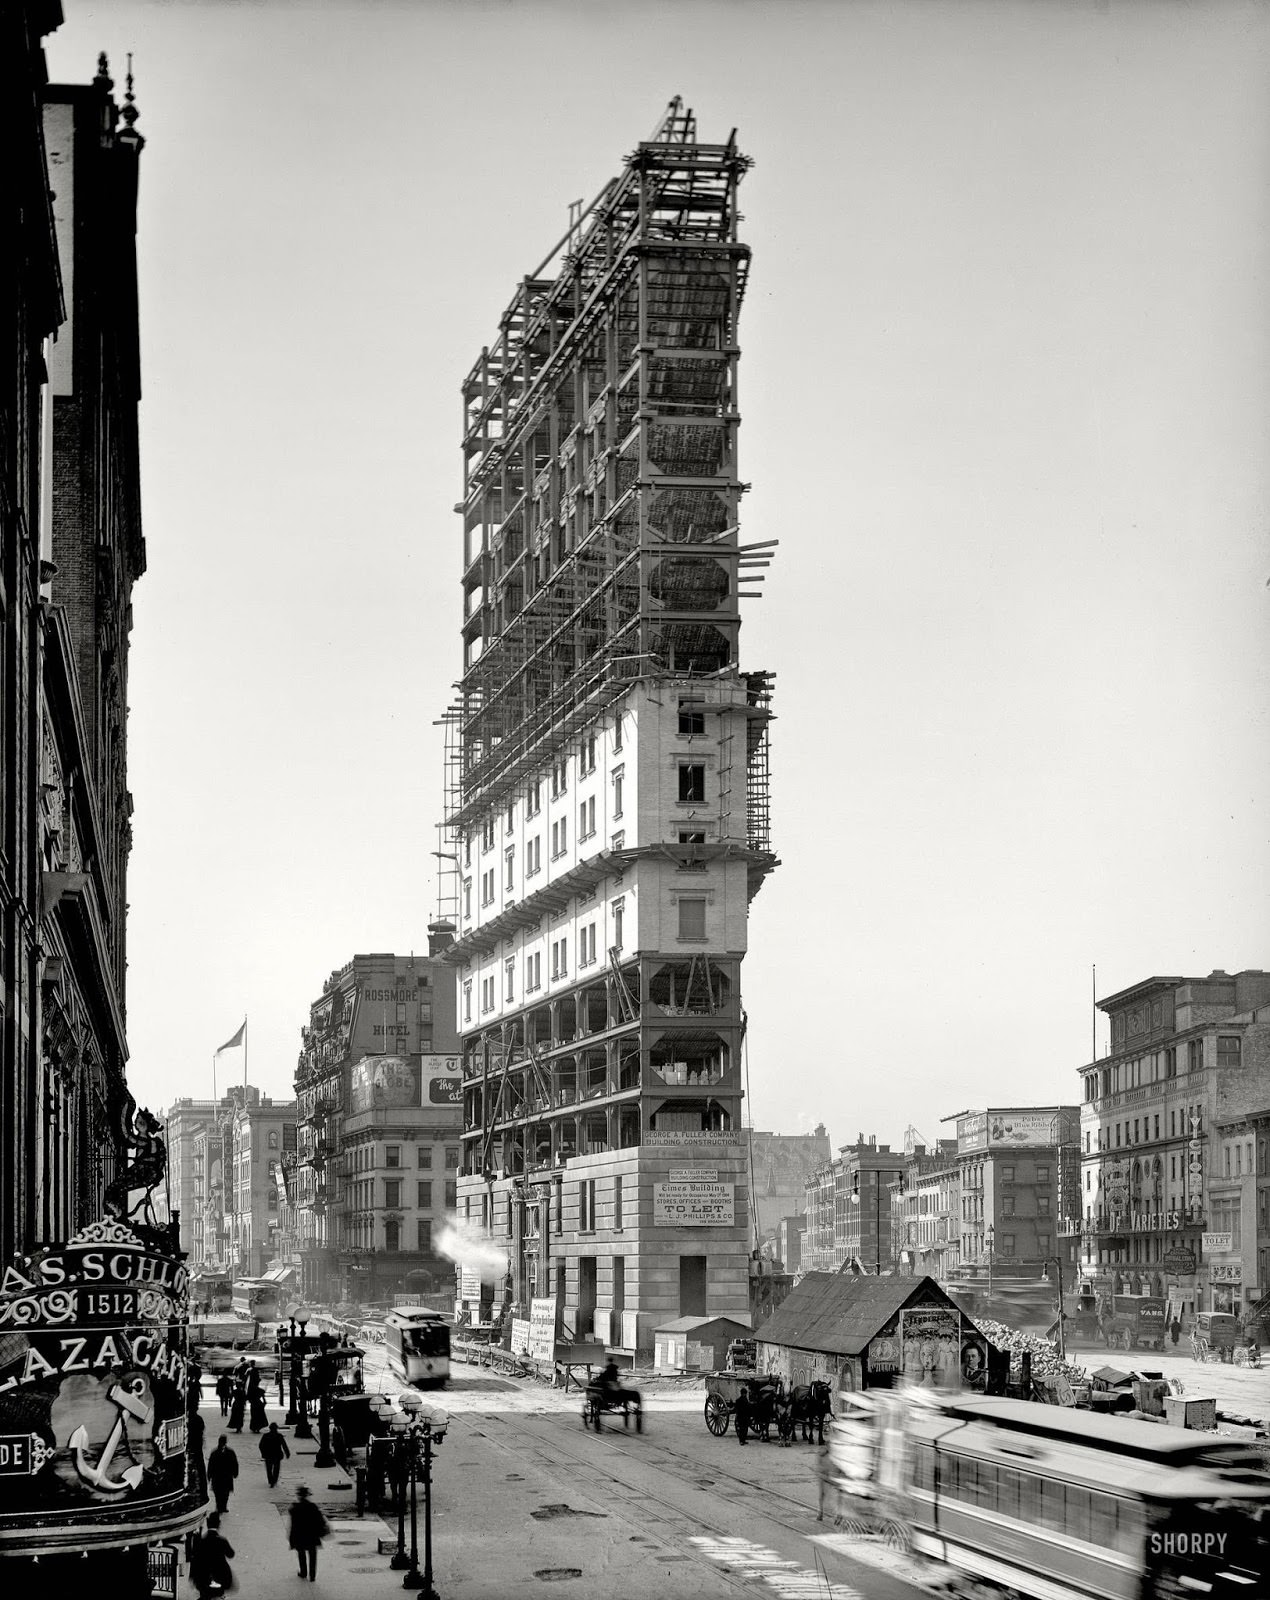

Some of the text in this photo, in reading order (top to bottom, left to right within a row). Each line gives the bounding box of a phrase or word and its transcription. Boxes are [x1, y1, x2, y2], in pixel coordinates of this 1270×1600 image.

[365, 989, 418, 1002] ROSSMORE
[373, 1025, 410, 1036] HOTEL
[381, 1064, 403, 1075] THE
[376, 1078, 412, 1088] GLOBE
[436, 1078, 455, 1091] The
[1189, 1117, 1202, 1207] VICTORIA
[661, 1184, 725, 1193] Times Building
[664, 1205, 723, 1213] TO LET
[1109, 1211, 1121, 1233] OF
[1130, 1210, 1179, 1232] VARIETIES
[87, 1293, 134, 1315] 1512
[0, 1443, 23, 1466] DE
